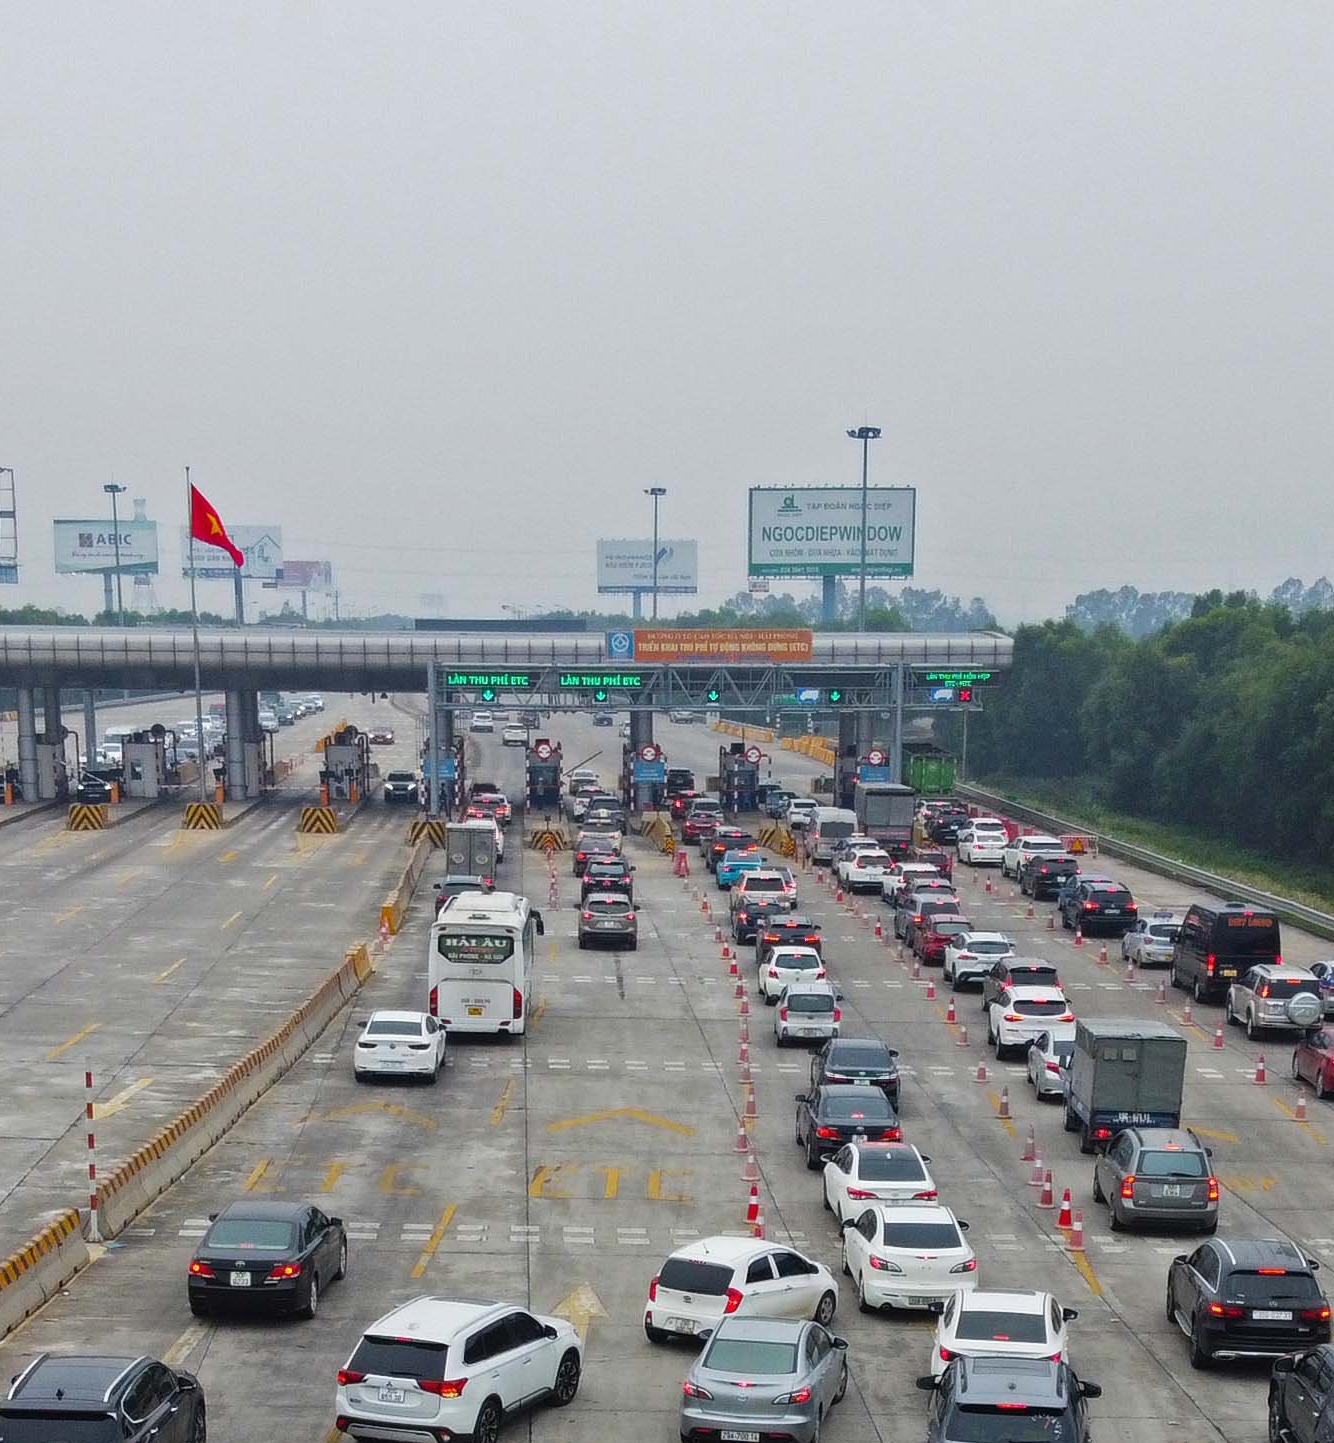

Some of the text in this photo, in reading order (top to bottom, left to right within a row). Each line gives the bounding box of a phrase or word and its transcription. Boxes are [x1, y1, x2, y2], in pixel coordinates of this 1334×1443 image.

[762, 526, 902, 542] NGOCDIEPWINDOW
[469, 675, 489, 685] THU
[491, 673, 509, 685] PHÍ
[511, 676, 529, 685] ETC
[582, 676, 601, 686] THU
[603, 674, 621, 686] PHÍ
[622, 676, 641, 686] ETC
[445, 935, 508, 947] HẢI ÂU
[529, 1164, 695, 1203] ETC
